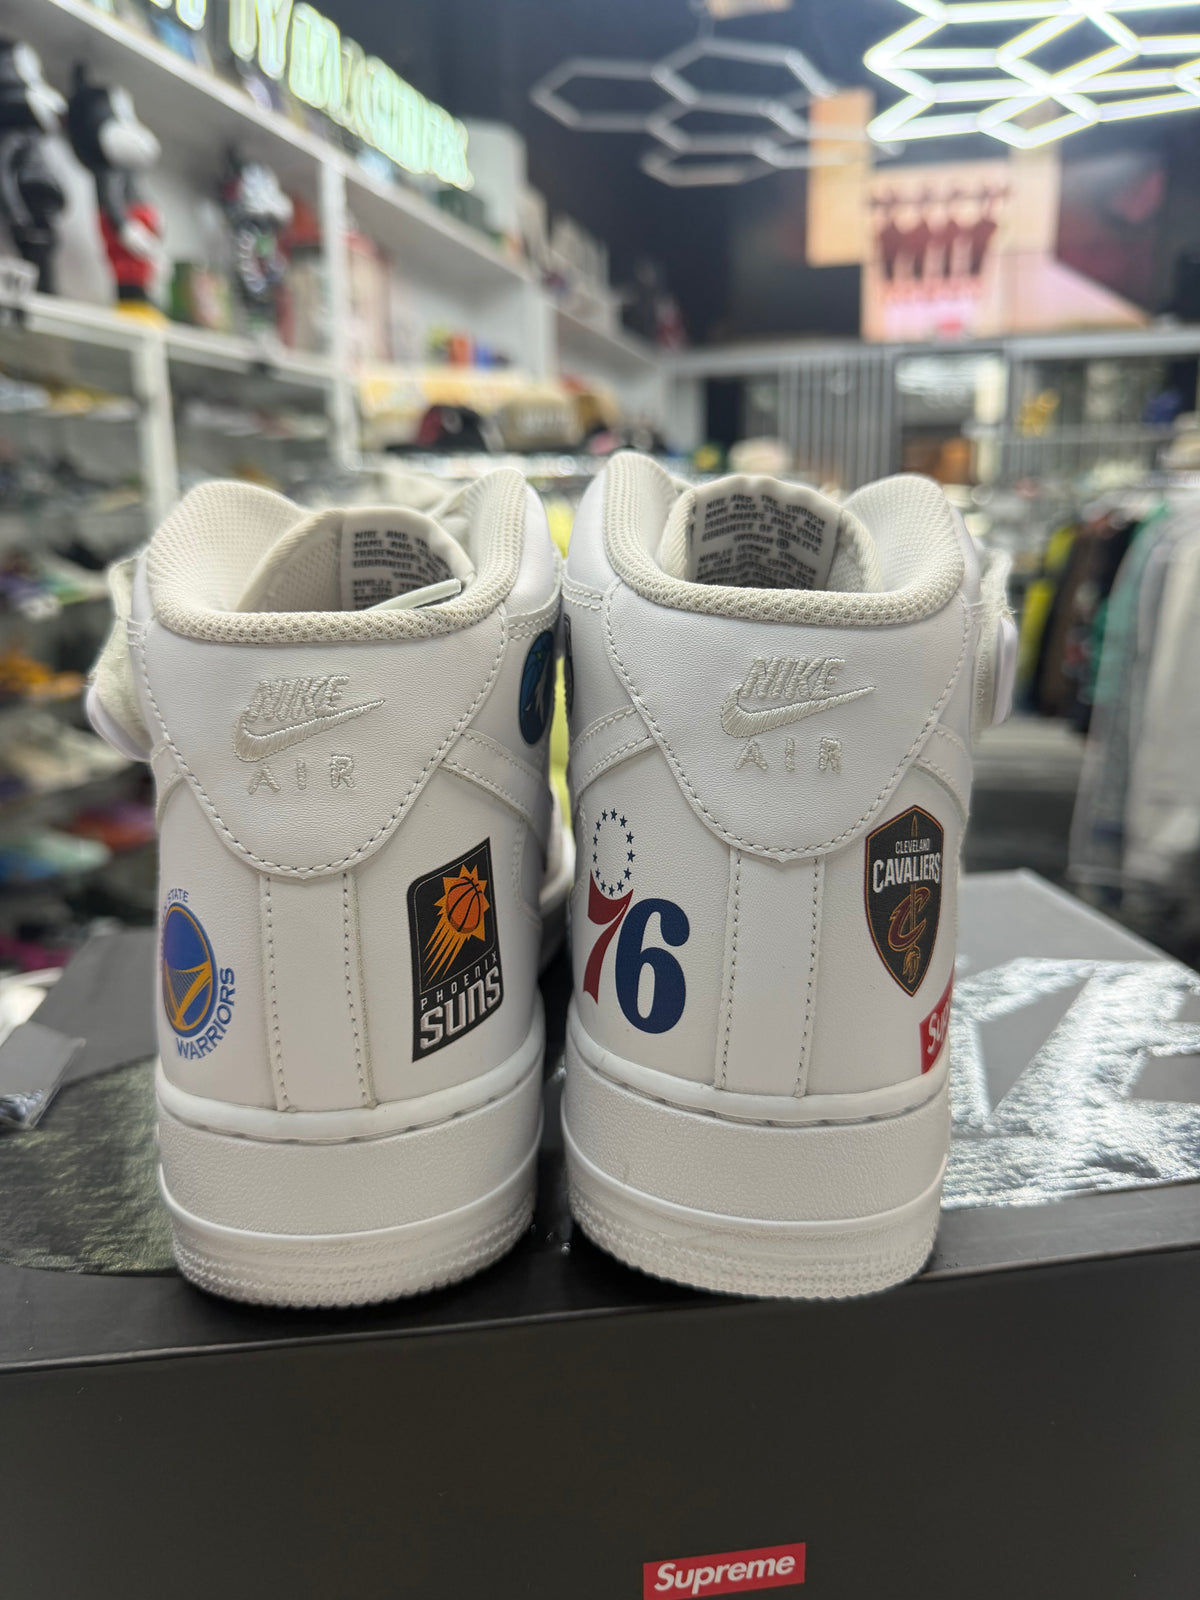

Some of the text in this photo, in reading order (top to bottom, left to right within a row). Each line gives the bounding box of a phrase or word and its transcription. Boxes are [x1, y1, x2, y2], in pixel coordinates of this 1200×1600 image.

[731, 494, 752, 503] AND
[734, 503, 756, 511] AND
[739, 656, 845, 700] NIKE
[247, 675, 350, 722] NIKE
[248, 755, 355, 795] AIR
[735, 737, 842, 774] AIR
[895, 838, 931, 854] CLEVELAND
[872, 852, 942, 893] CAVALIERS
[583, 869, 690, 1034] 76
[421, 951, 497, 1011] PHOENIX
[176, 967, 236, 1060] WARRIORS
[654, 1555, 796, 1595] Supreme
